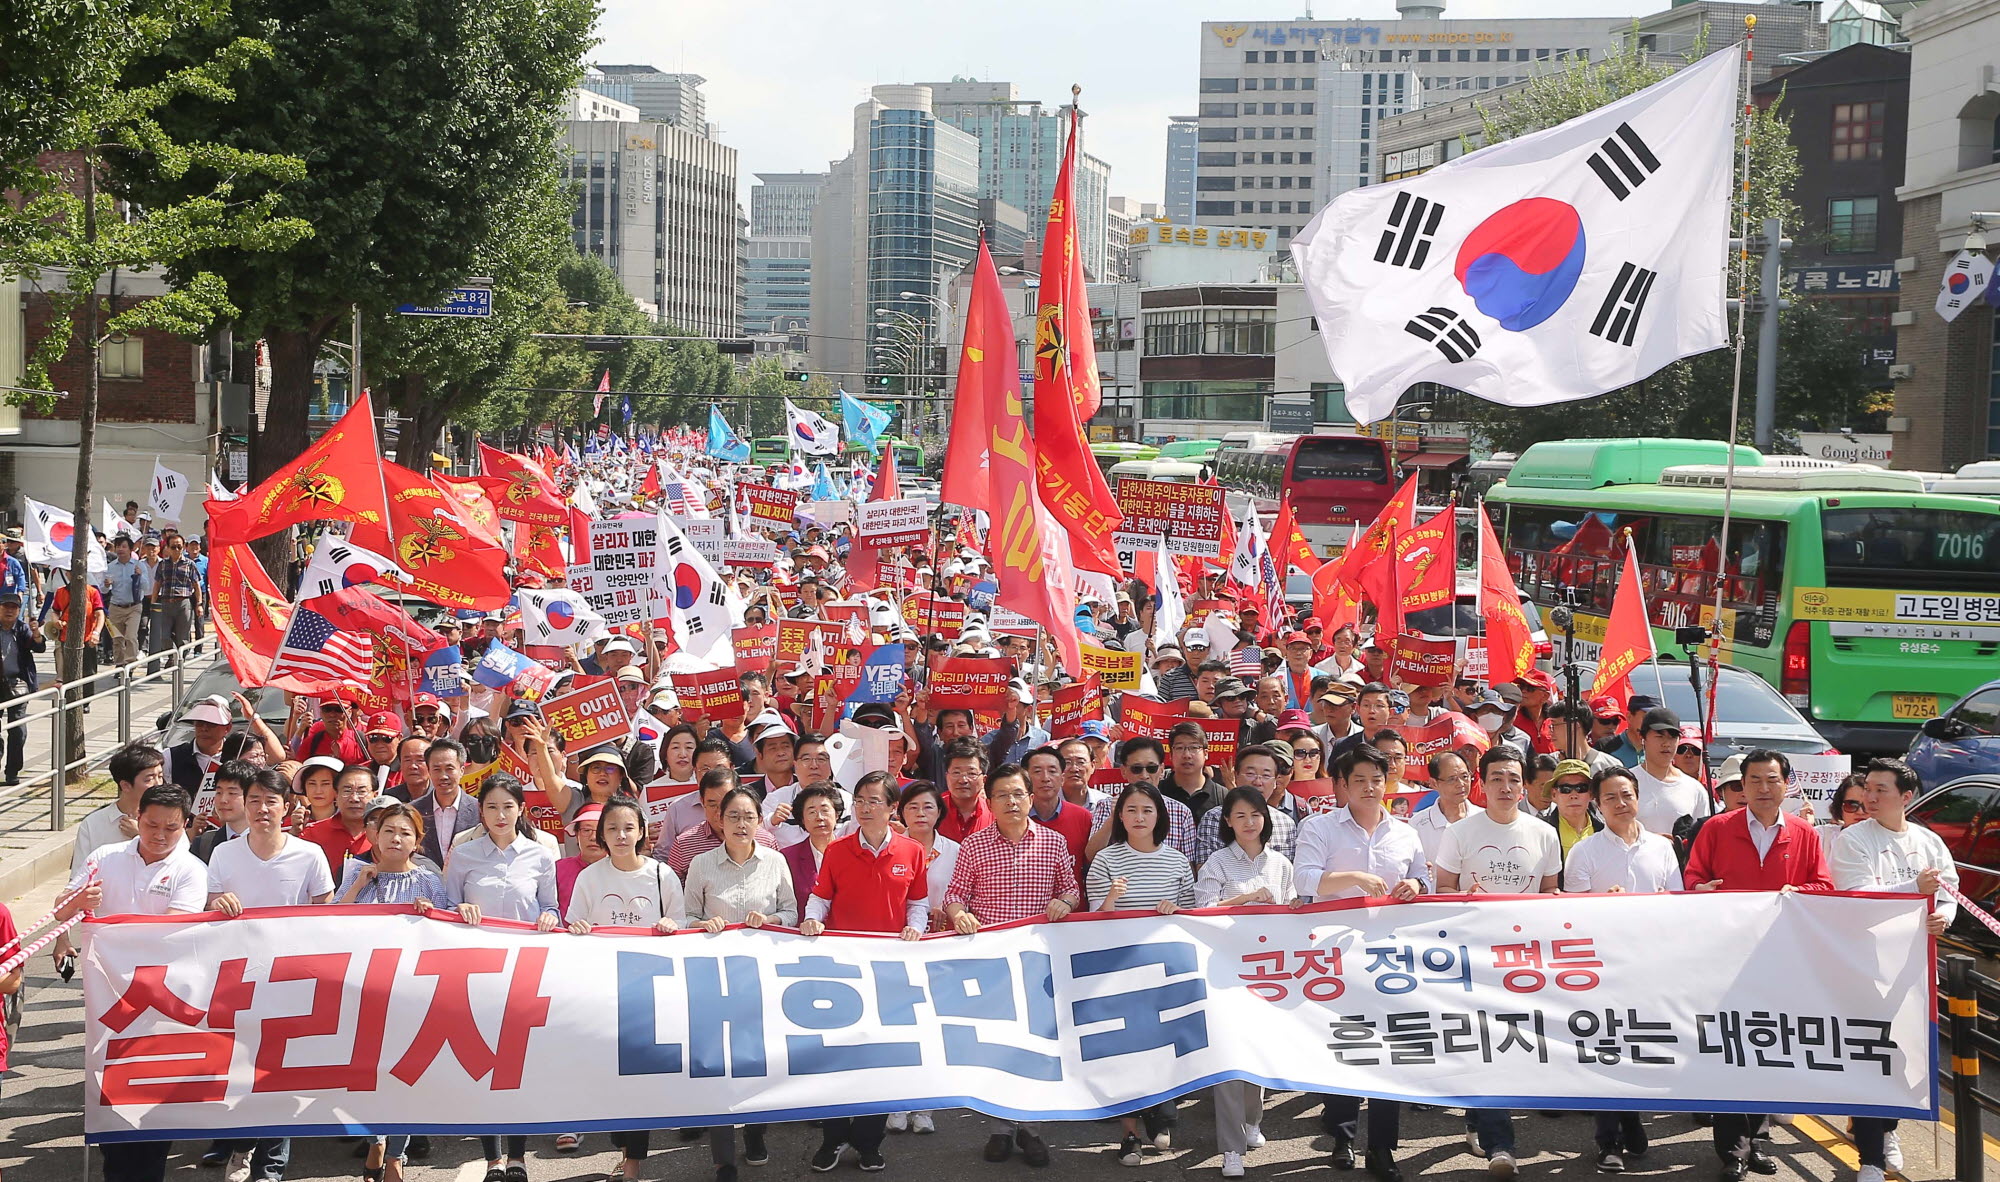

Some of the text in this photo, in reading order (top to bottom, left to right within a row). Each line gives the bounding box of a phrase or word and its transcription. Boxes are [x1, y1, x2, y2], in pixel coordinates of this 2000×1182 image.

[1253, 27, 1380, 45] 서울지방경찰청
[1158, 226, 1268, 249] 토속촌 삼계탕
[1822, 444, 1886, 463] Gong cha
[758, 490, 794, 507] 대한민국!
[1121, 480, 1221, 506] 남한사회주의노동자동맹이
[754, 504, 771, 517] 파괴
[772, 507, 793, 521] 저지!
[866, 505, 920, 520] 살리자 대한민국!
[1120, 499, 1219, 522] 대한민국 검사들을 지휘하는
[862, 515, 925, 531] 대한민국 파괴 저지!
[1171, 521, 1195, 537] 꿈꾸는
[1196, 523, 1218, 538] 조국?
[592, 532, 629, 551] 살리자
[738, 542, 769, 551] 대한민국!
[1121, 535, 1219, 554] 자유한국당 당원협의회
[1937, 533, 1984, 559] 7016
[594, 552, 636, 572] 대한민국
[606, 573, 649, 588] 안양만안
[616, 589, 636, 607] 파괴
[971, 589, 993, 600] YES
[1662, 601, 1688, 627] 7016
[1896, 596, 2000, 622] 고도일병원
[781, 627, 805, 641] 조국
[781, 641, 806, 655] 文정
[1900, 642, 1941, 653] 유성운수
[1083, 653, 1135, 669] 조로남불
[1398, 649, 1453, 664] 아빠가 조국이
[424, 663, 461, 679] YES
[865, 664, 903, 682] YES
[1396, 660, 1429, 673] 아니라서
[699, 680, 738, 696] 사퇴하고
[706, 693, 740, 707] 사죄하라
[1055, 701, 1080, 714] 아빠가
[548, 693, 617, 728] 조국 OUT!
[1125, 708, 1152, 725] 아빠가
[1904, 704, 1937, 717] 7254
[599, 710, 623, 730] NO!
[1425, 735, 1453, 752] 조국이
[1810, 771, 1833, 784] 공정?
[1238, 938, 1604, 1002] 공정 정의 평등
[98, 942, 1209, 1106] 살리자 대한민국
[1327, 1008, 1898, 1076] 흔들리지 않는 대한민국
